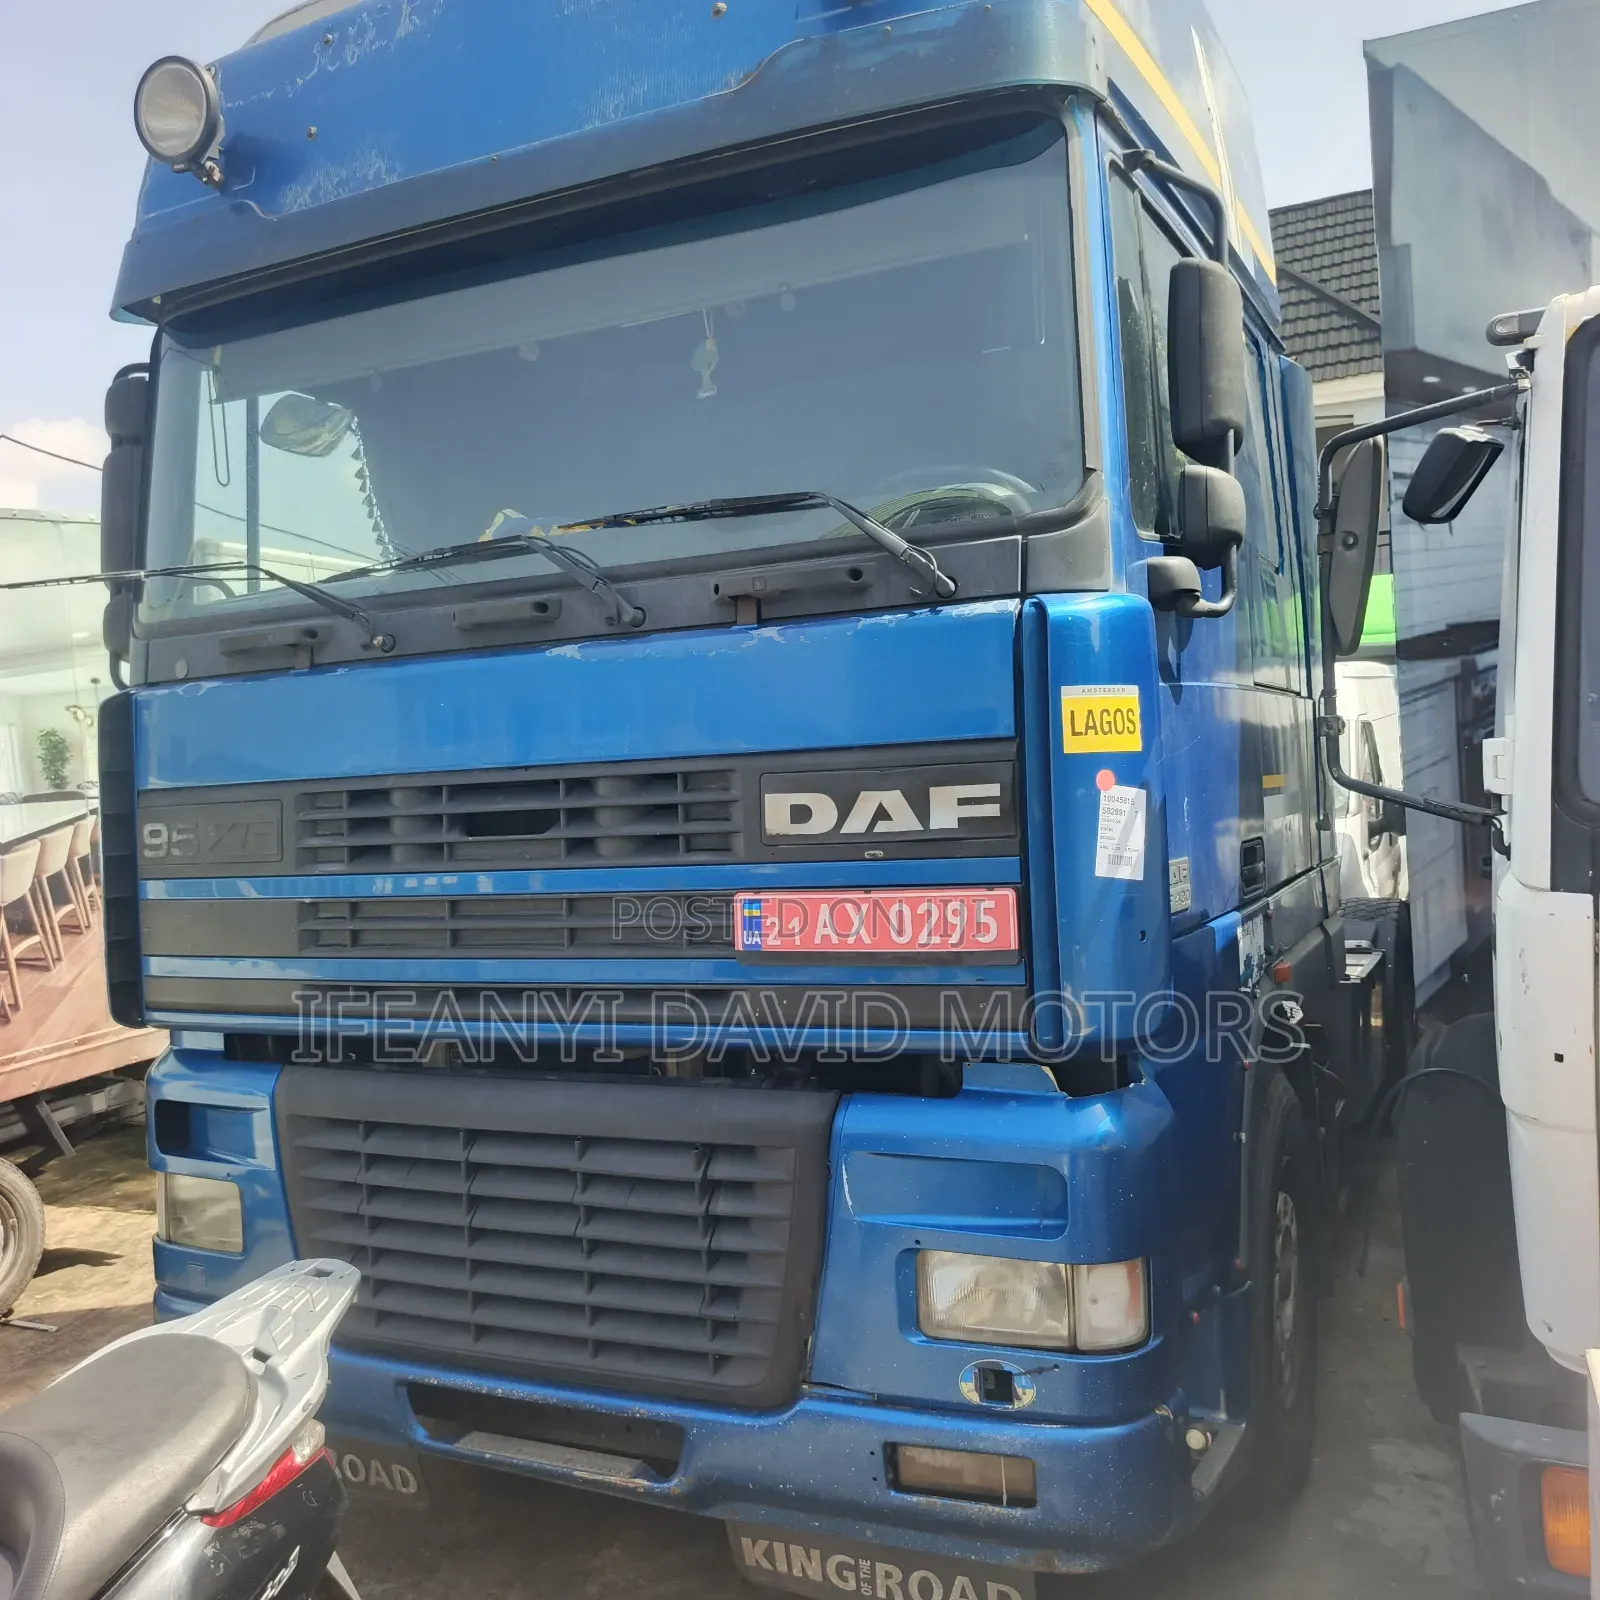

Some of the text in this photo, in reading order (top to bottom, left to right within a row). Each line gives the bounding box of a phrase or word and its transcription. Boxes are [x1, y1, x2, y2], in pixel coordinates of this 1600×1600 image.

[1069, 707, 1137, 737] LAGOS
[764, 782, 1001, 836] DAF
[743, 930, 762, 945] UA
[765, 900, 999, 946] 21 AX 0295
[334, 1452, 418, 1494] OAD
[740, 1536, 857, 1591] KING
[858, 1558, 871, 1580] THE
[860, 1579, 872, 1597] OF
